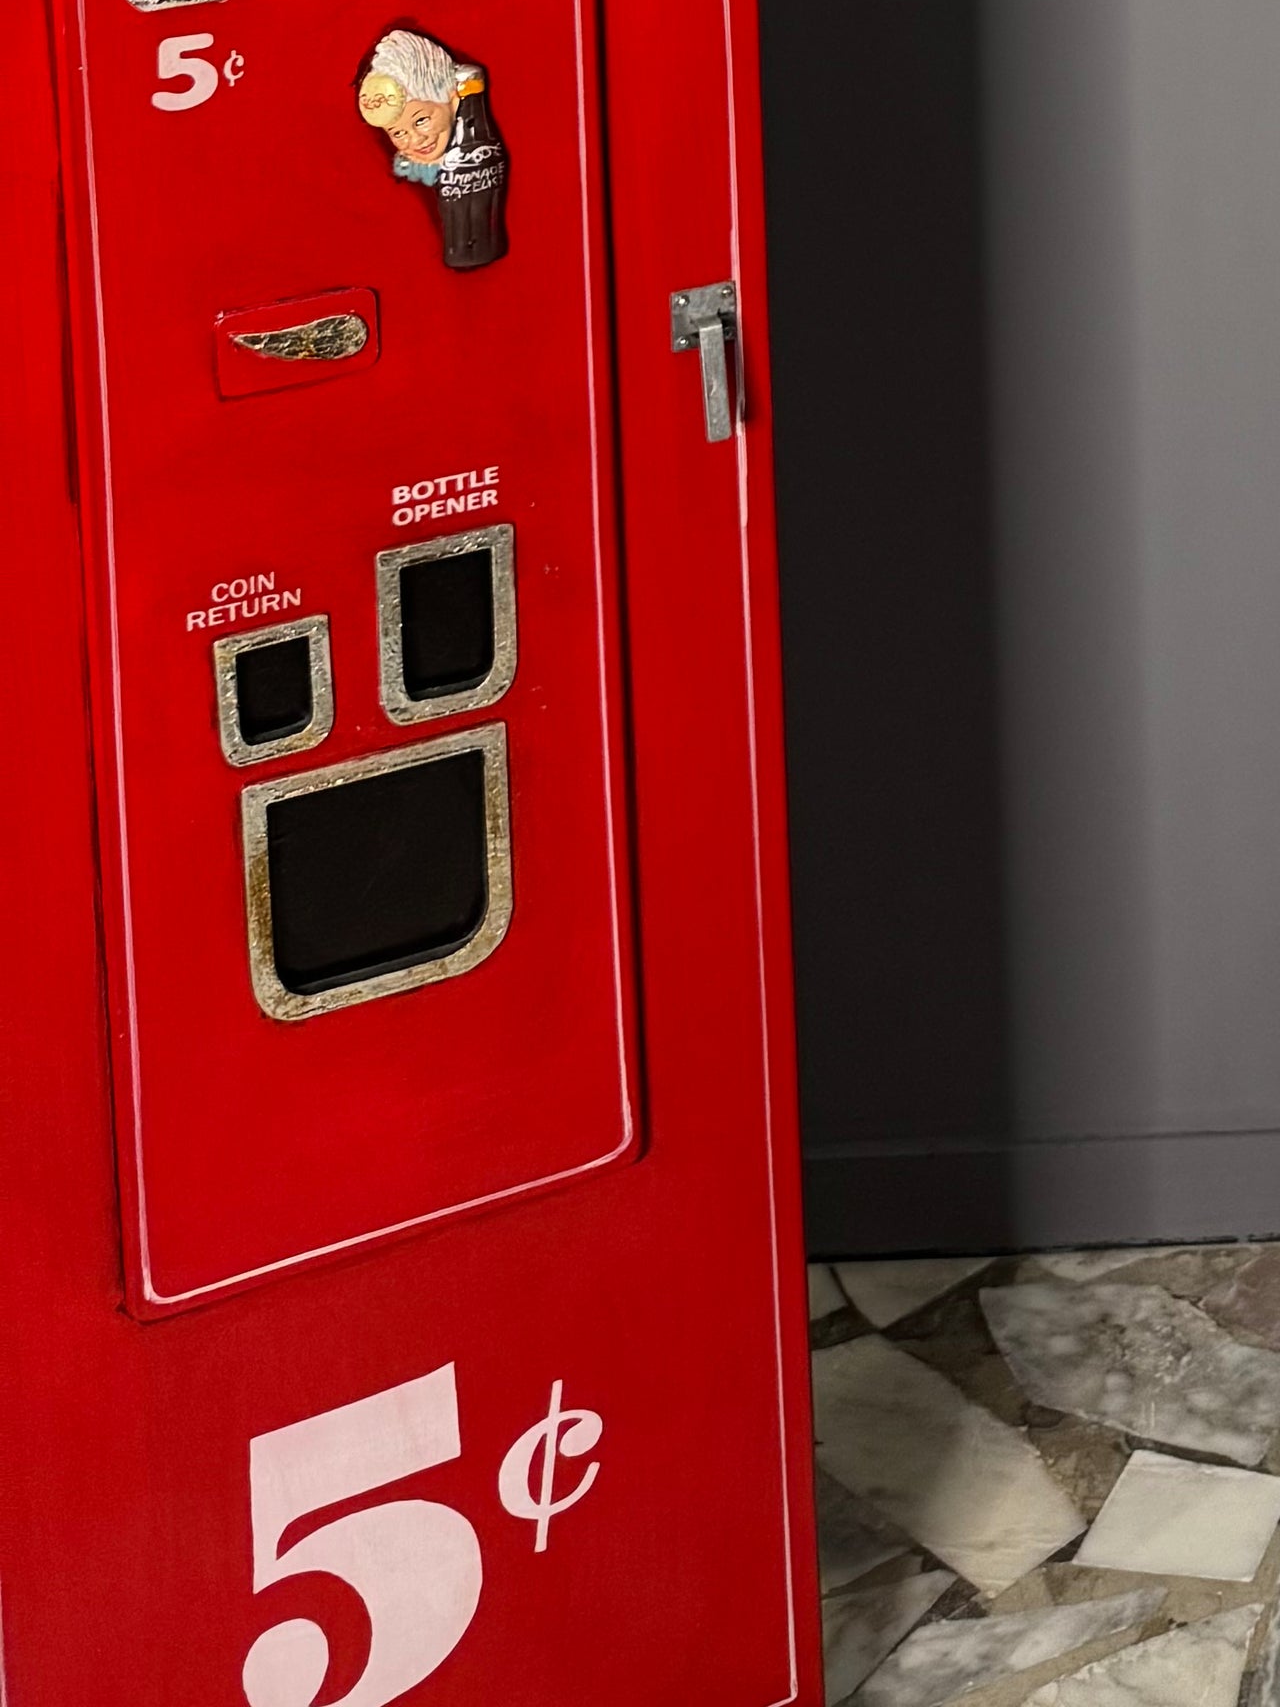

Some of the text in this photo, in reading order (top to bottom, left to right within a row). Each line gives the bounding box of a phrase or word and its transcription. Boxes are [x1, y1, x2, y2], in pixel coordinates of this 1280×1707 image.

[391, 466, 500, 506] BOTTLE
[391, 489, 499, 527] OPENER
[210, 571, 276, 603] COIN
[186, 588, 302, 632] RETURN
